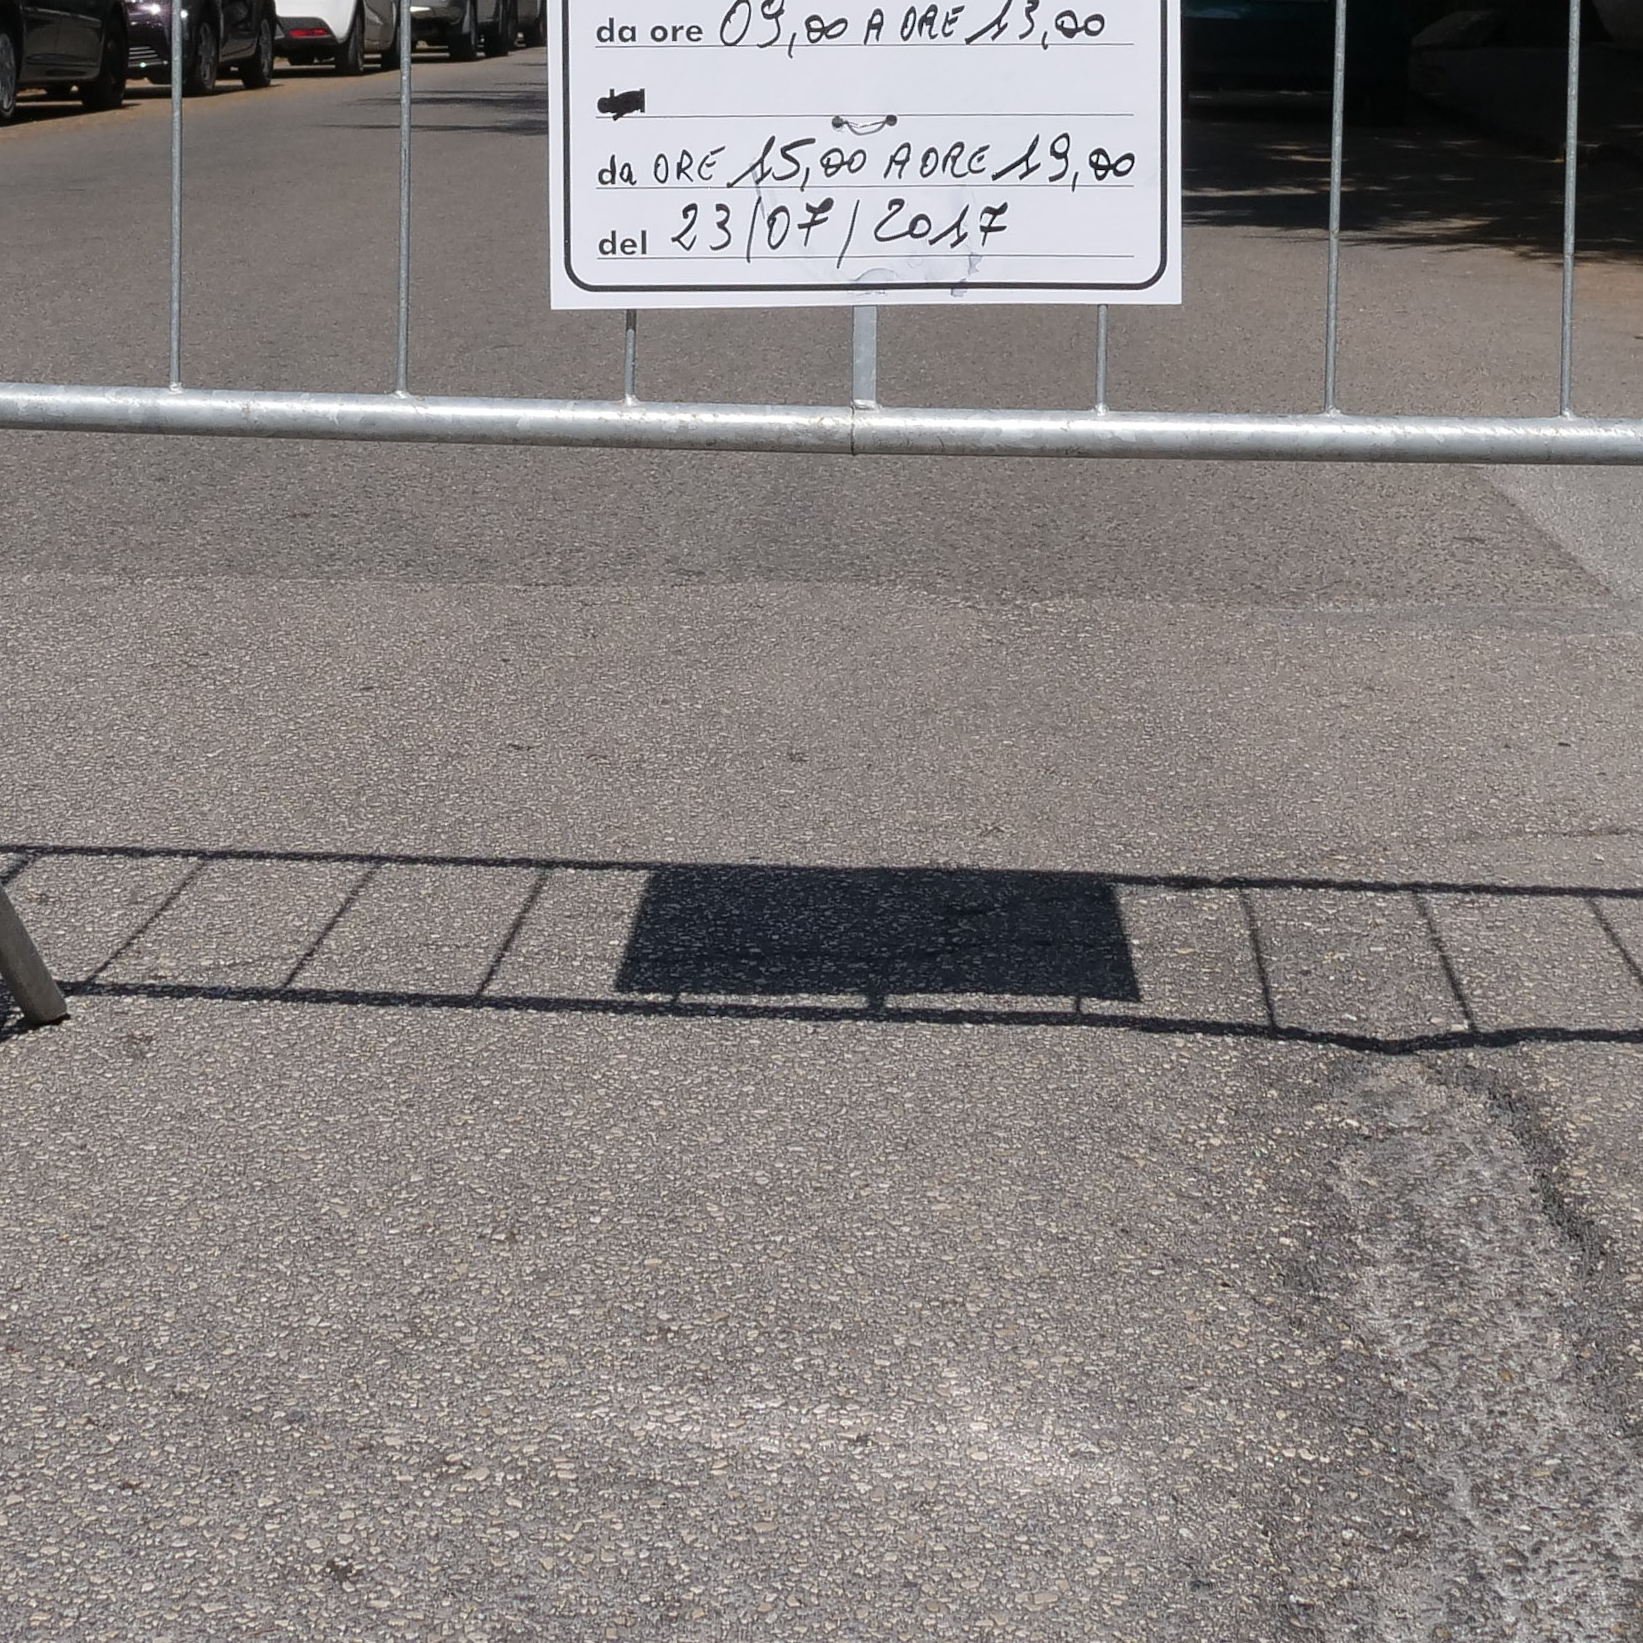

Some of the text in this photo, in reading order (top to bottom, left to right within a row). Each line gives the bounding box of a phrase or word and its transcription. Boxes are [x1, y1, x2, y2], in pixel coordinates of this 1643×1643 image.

[596, 17, 637, 43] da
[650, 25, 703, 43] ore
[900, 4, 965, 42] ORE
[598, 154, 637, 187] da
[653, 145, 727, 184] ORE
[726, 136, 867, 192] 15,00
[919, 141, 991, 180] ORE
[991, 132, 1136, 192] 19,00
[598, 197, 1009, 269] del 23/07/2017
